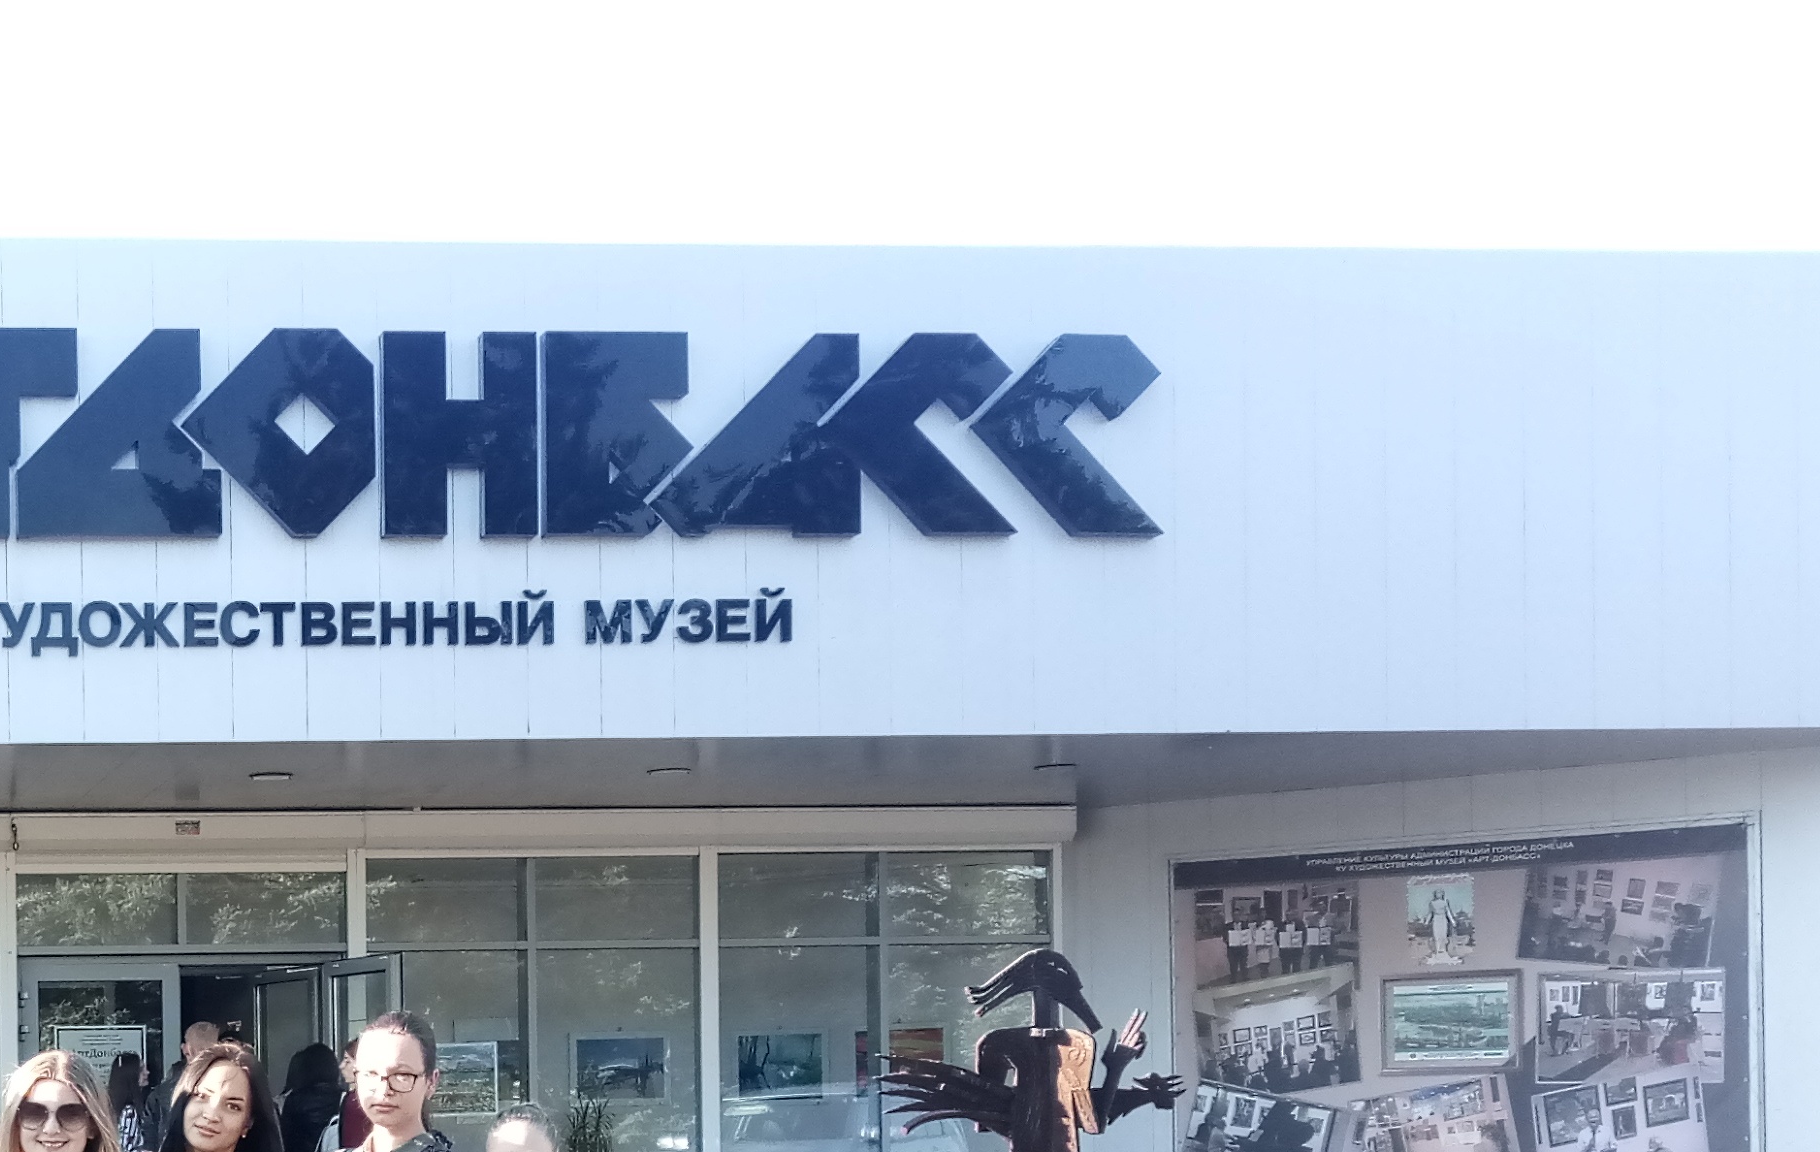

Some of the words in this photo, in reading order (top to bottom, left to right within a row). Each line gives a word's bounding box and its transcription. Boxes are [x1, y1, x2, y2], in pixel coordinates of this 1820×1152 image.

[583, 587, 794, 646] МУЗЕЙ
[1306, 856, 1362, 866] УПРАВЛЕНИЕ
[1363, 853, 1408, 862] КУЛЬТУРЫ
[1492, 845, 1528, 854] ГОРОДА
[1529, 841, 1574, 852] ДОНЕЦКА
[1348, 860, 1433, 871] ХУДОЖЕСТВЕННЫЙ
[1435, 857, 1466, 865] МУЗЕЙ
